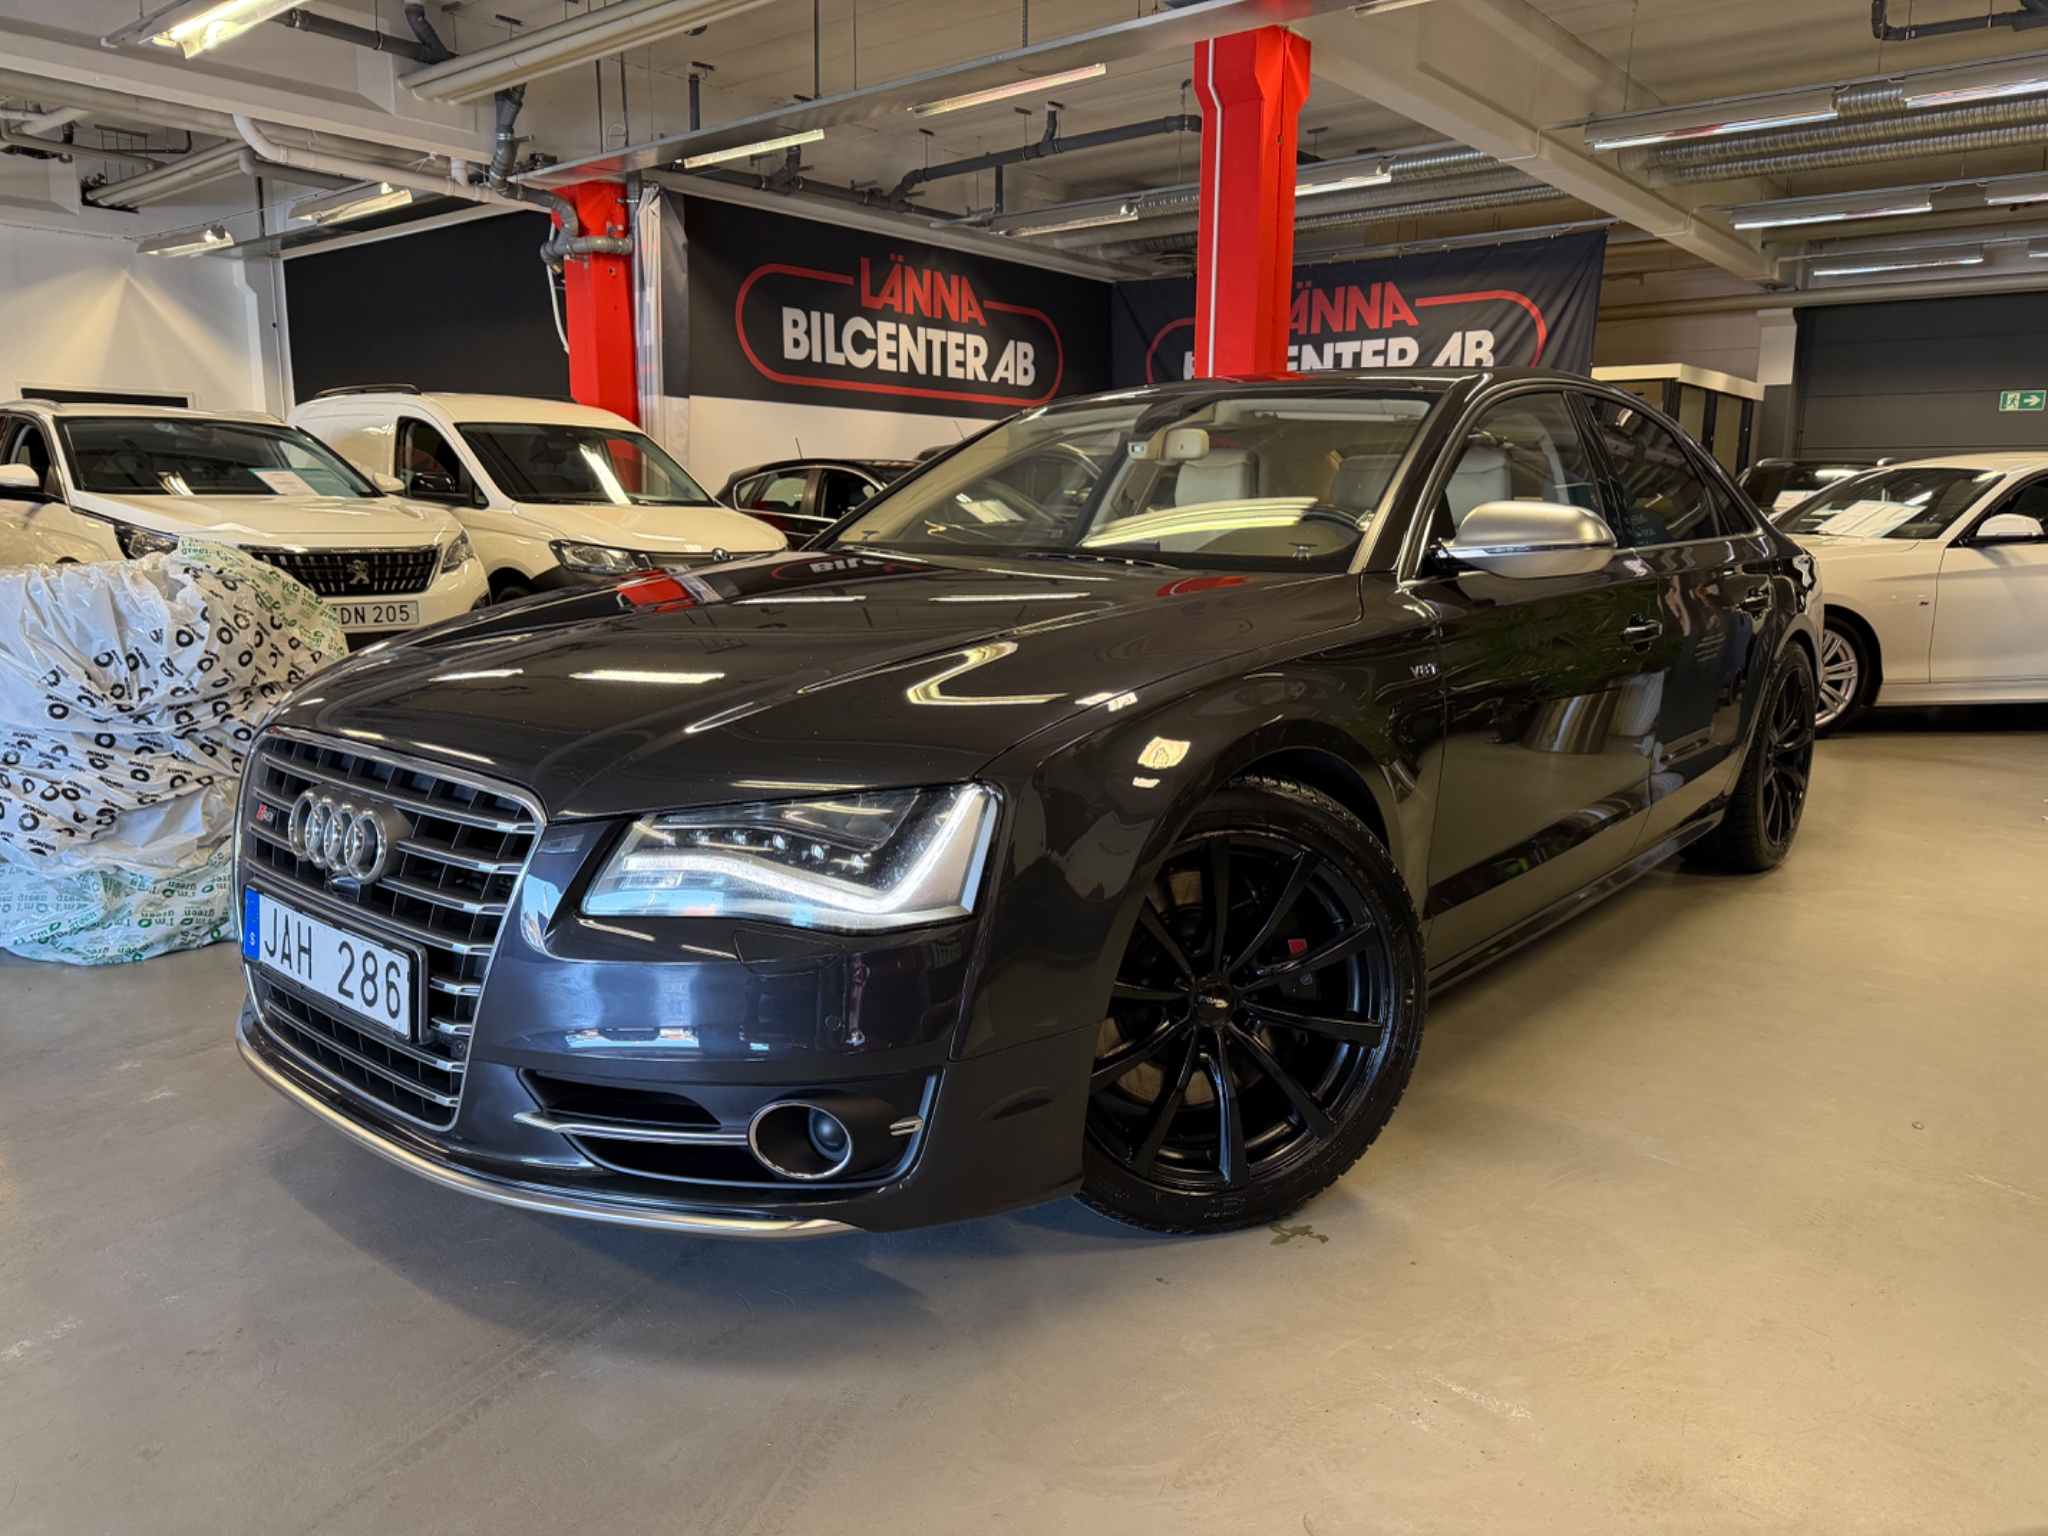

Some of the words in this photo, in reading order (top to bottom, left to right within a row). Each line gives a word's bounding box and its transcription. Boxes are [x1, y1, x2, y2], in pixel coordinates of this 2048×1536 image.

[860, 253, 987, 326] LÄNNA
[1290, 281, 1419, 335] ÄNNA
[782, 306, 989, 383] BILCENTER
[990, 339, 1036, 387] AB
[333, 606, 365, 624] DN
[372, 605, 410, 622] 205
[265, 908, 312, 980] JAH
[338, 941, 401, 1019] 286
